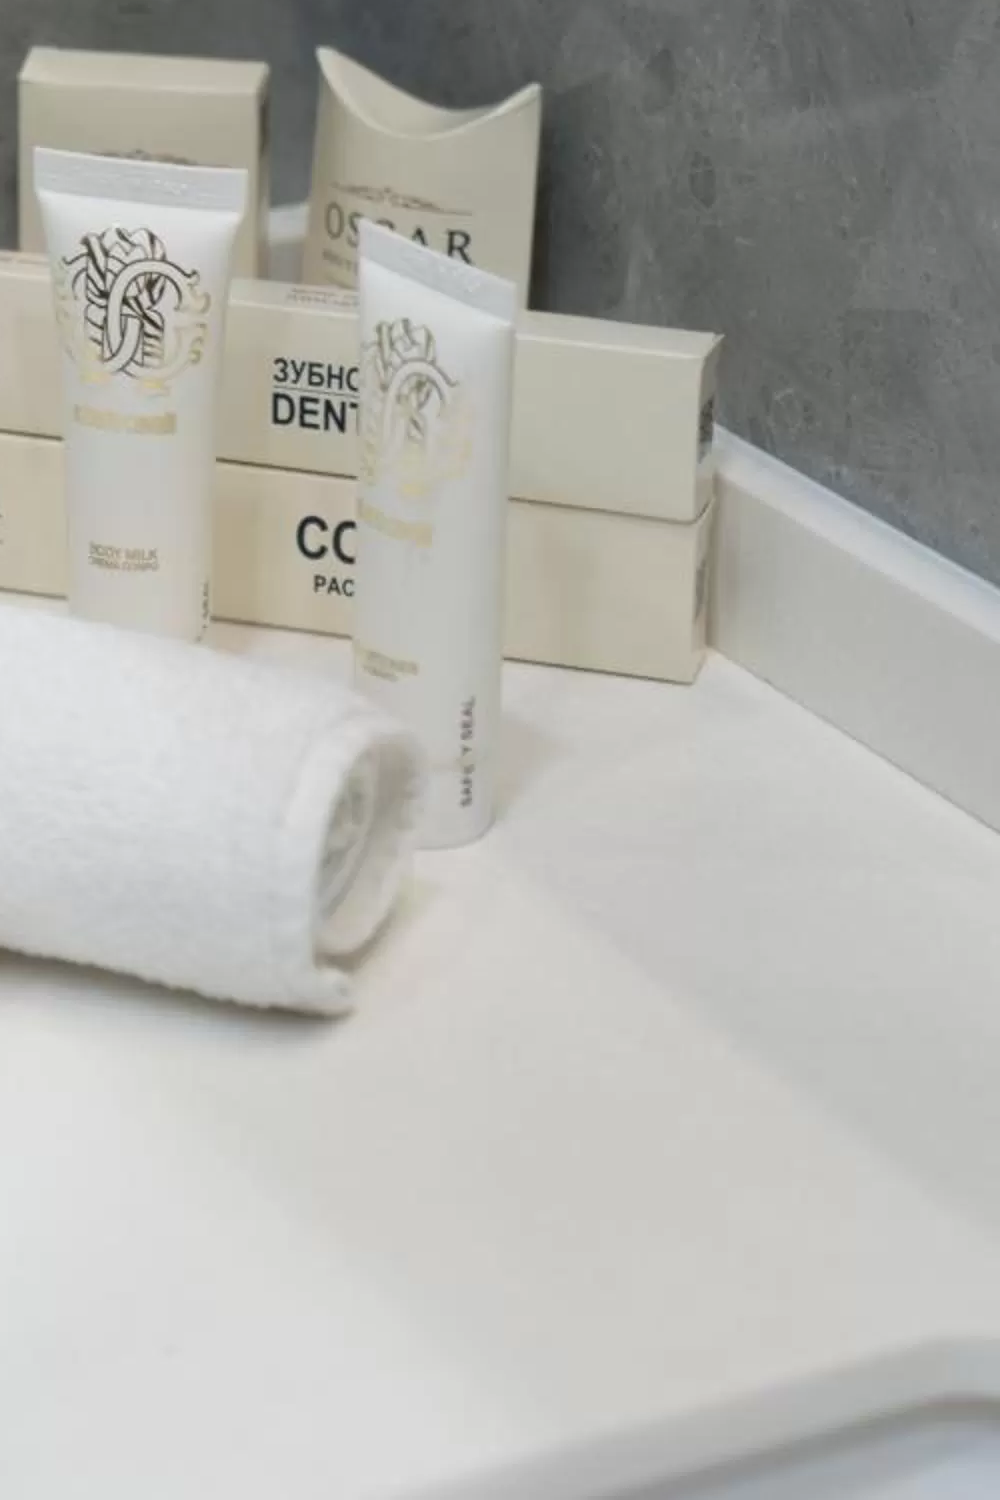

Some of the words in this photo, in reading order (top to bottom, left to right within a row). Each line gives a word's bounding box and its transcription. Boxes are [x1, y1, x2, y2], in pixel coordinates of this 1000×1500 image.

[124, 547, 158, 561] MILK
[460, 696, 475, 740] SEAL
[459, 743, 475, 808] SAFEY
